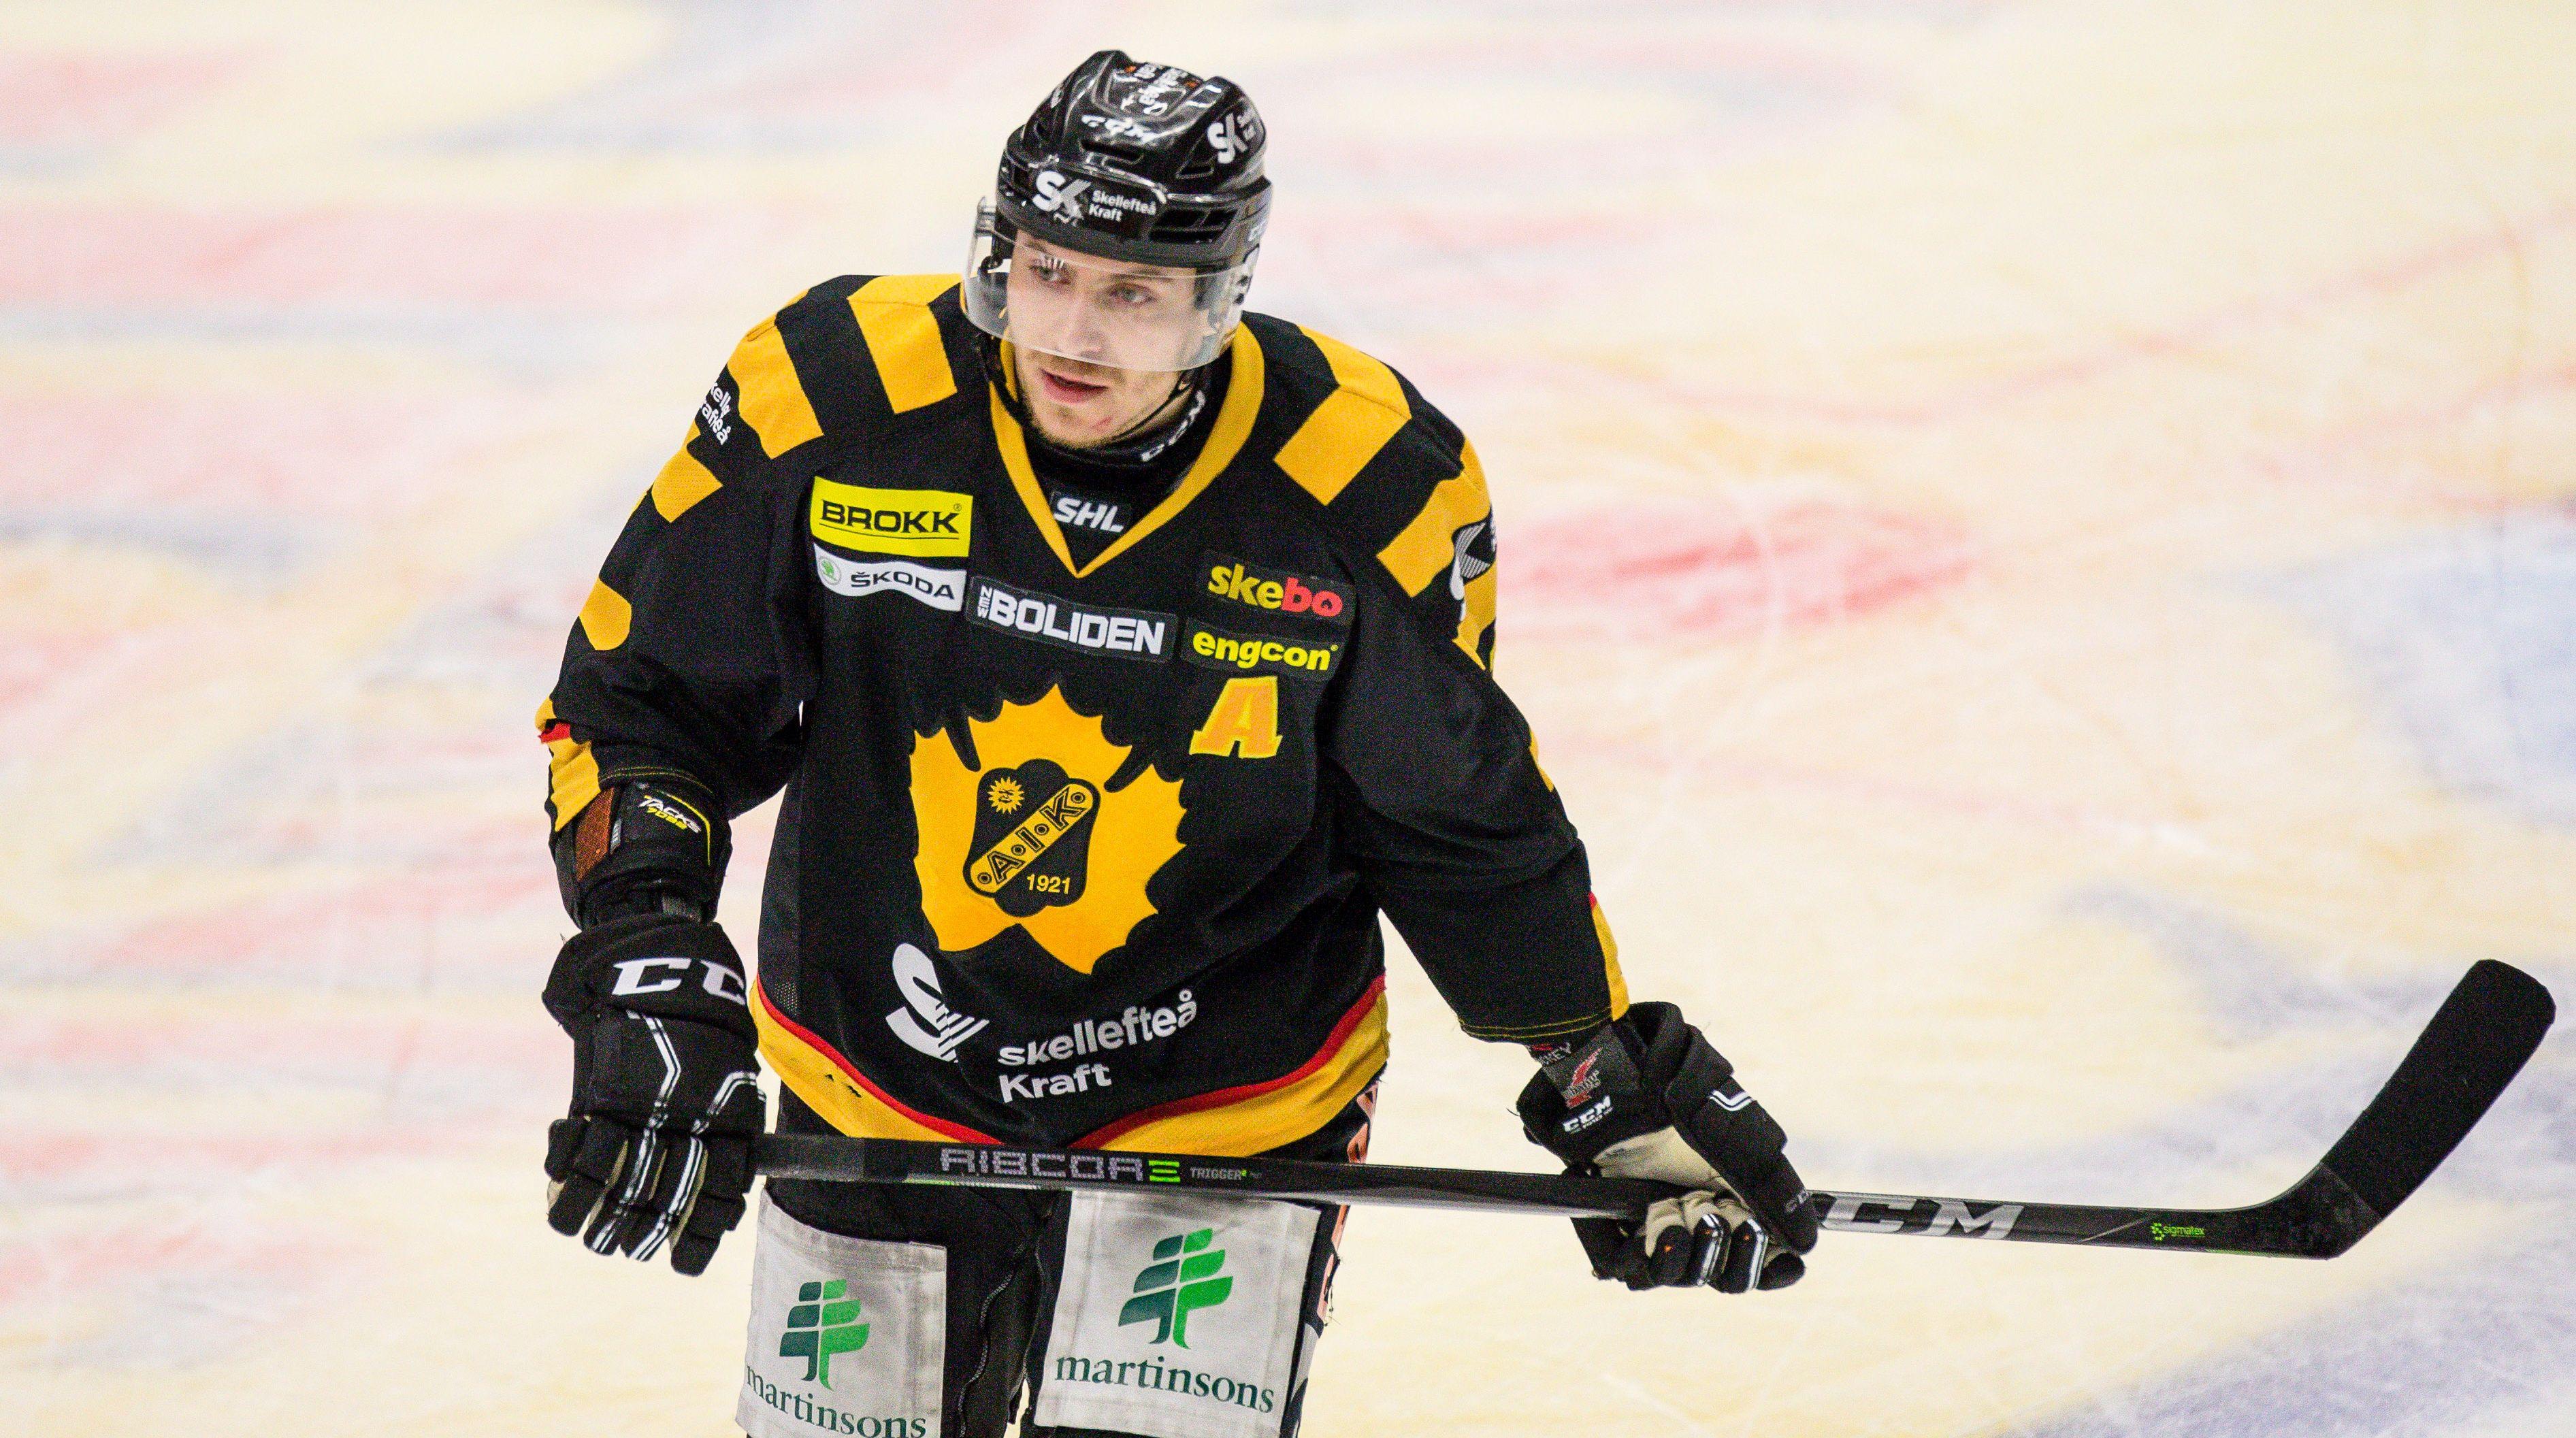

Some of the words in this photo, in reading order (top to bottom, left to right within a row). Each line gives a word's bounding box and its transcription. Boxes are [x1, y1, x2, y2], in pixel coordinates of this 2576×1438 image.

[1089, 203, 1123, 222] Kraft
[821, 500, 960, 534] BROKK
[1054, 497, 1124, 532] SHL
[851, 571, 954, 601] ŠKODA
[1208, 563, 1343, 617] skebo
[989, 589, 1166, 655] BOLIDEN
[1193, 631, 1331, 671] engcon
[1189, 675, 1284, 759] A
[1027, 873, 1071, 895] 1921
[998, 1062, 1113, 1104] Kraft
[1563, 1095, 1612, 1132] CCM
[1821, 1192, 2025, 1239] CM
[747, 1365, 927, 1438] martinsons
[1055, 1356, 1275, 1414] martinsons
